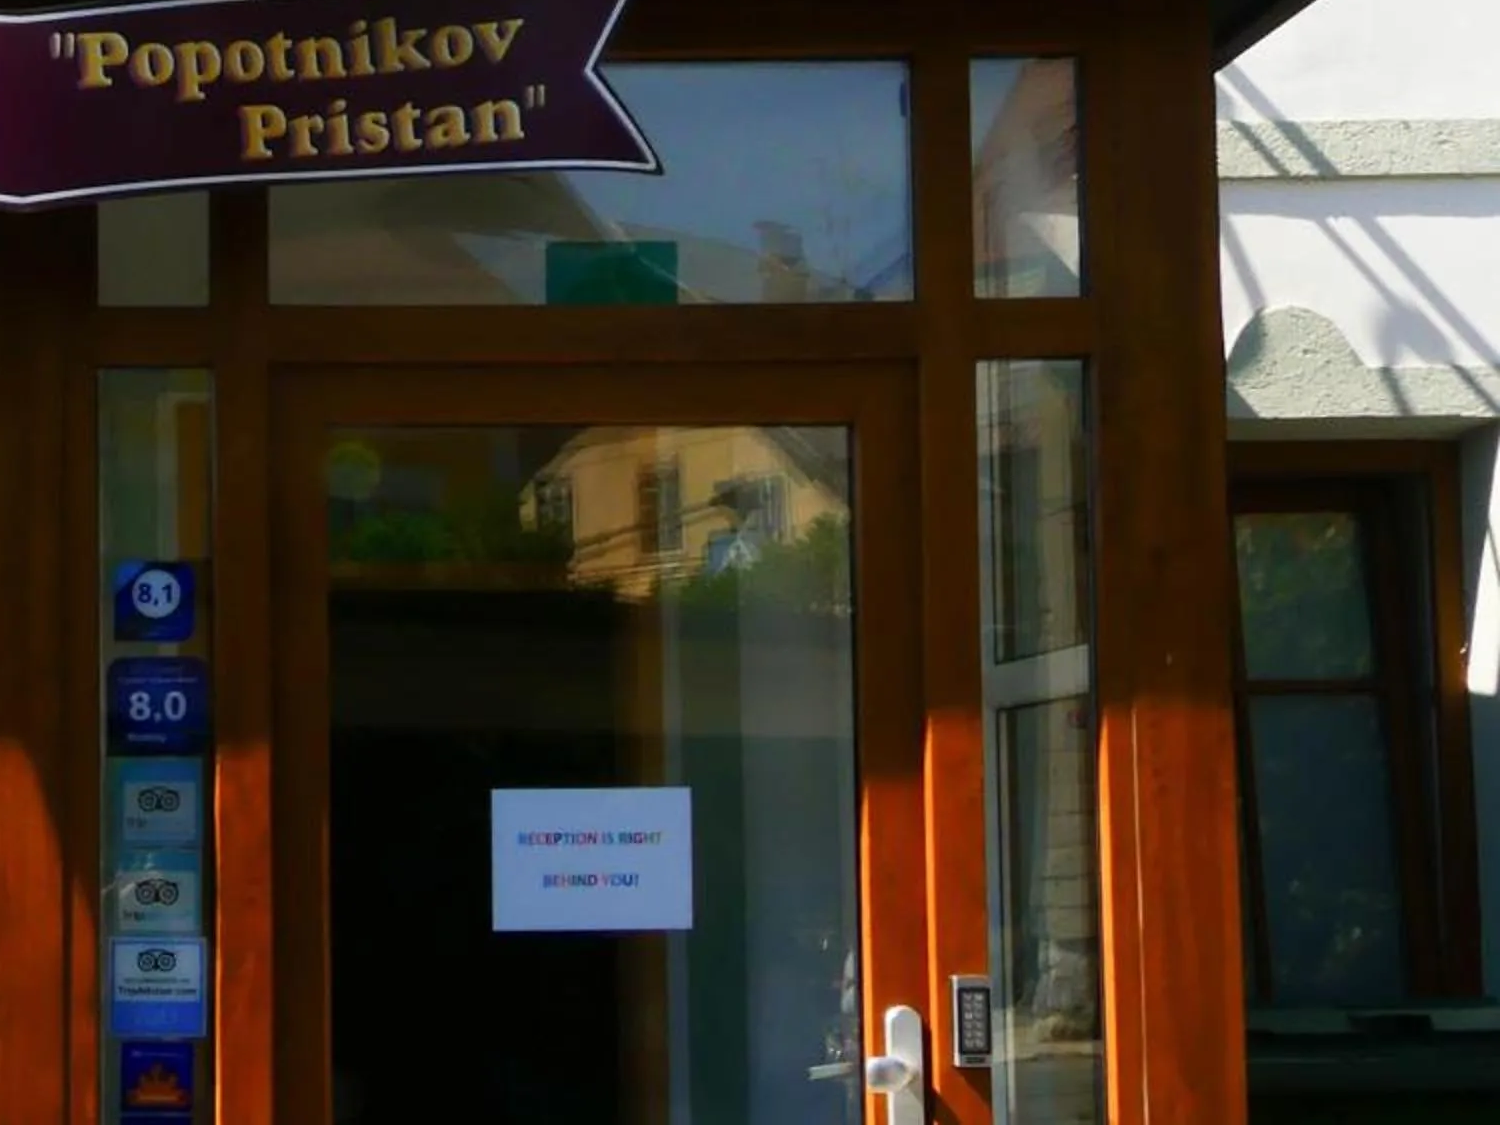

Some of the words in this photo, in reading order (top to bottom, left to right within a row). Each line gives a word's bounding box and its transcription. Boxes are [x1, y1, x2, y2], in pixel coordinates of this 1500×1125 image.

[48, 17, 525, 102] "Popotnikov
[237, 82, 548, 161] Pristan"
[518, 831, 597, 845] RECEPTION
[601, 831, 614, 845] IS
[618, 830, 662, 845] RIGHT
[542, 873, 598, 888] BEHIND
